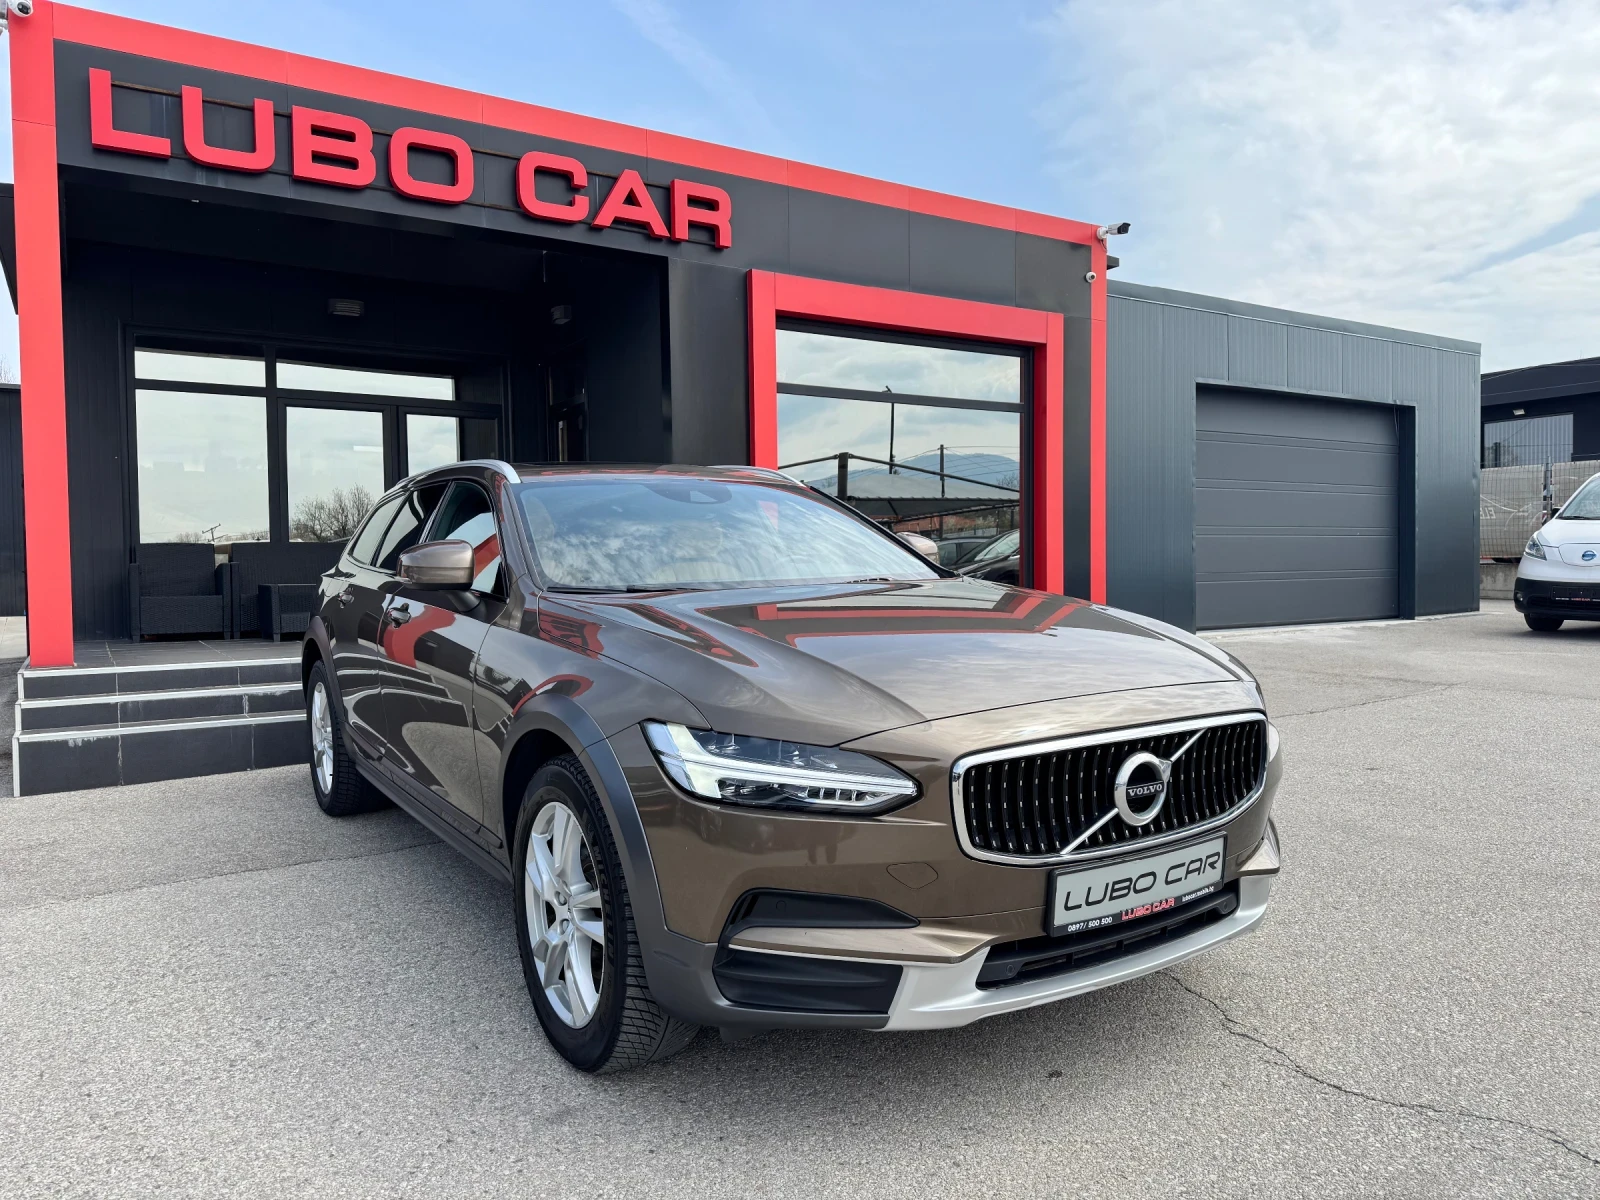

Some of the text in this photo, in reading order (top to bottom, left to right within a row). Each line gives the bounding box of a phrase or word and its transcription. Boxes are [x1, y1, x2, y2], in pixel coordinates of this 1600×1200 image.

[89, 67, 732, 249] LUBO CAR
[1128, 784, 1162, 797] VOLVO
[1063, 851, 1220, 912] LUBO CAR
[591, 843, 615, 967] MICHELIN
[1088, 918, 1100, 929] 500
[1100, 916, 1113, 926] 500
[1121, 897, 1175, 921] LUBO CAR
